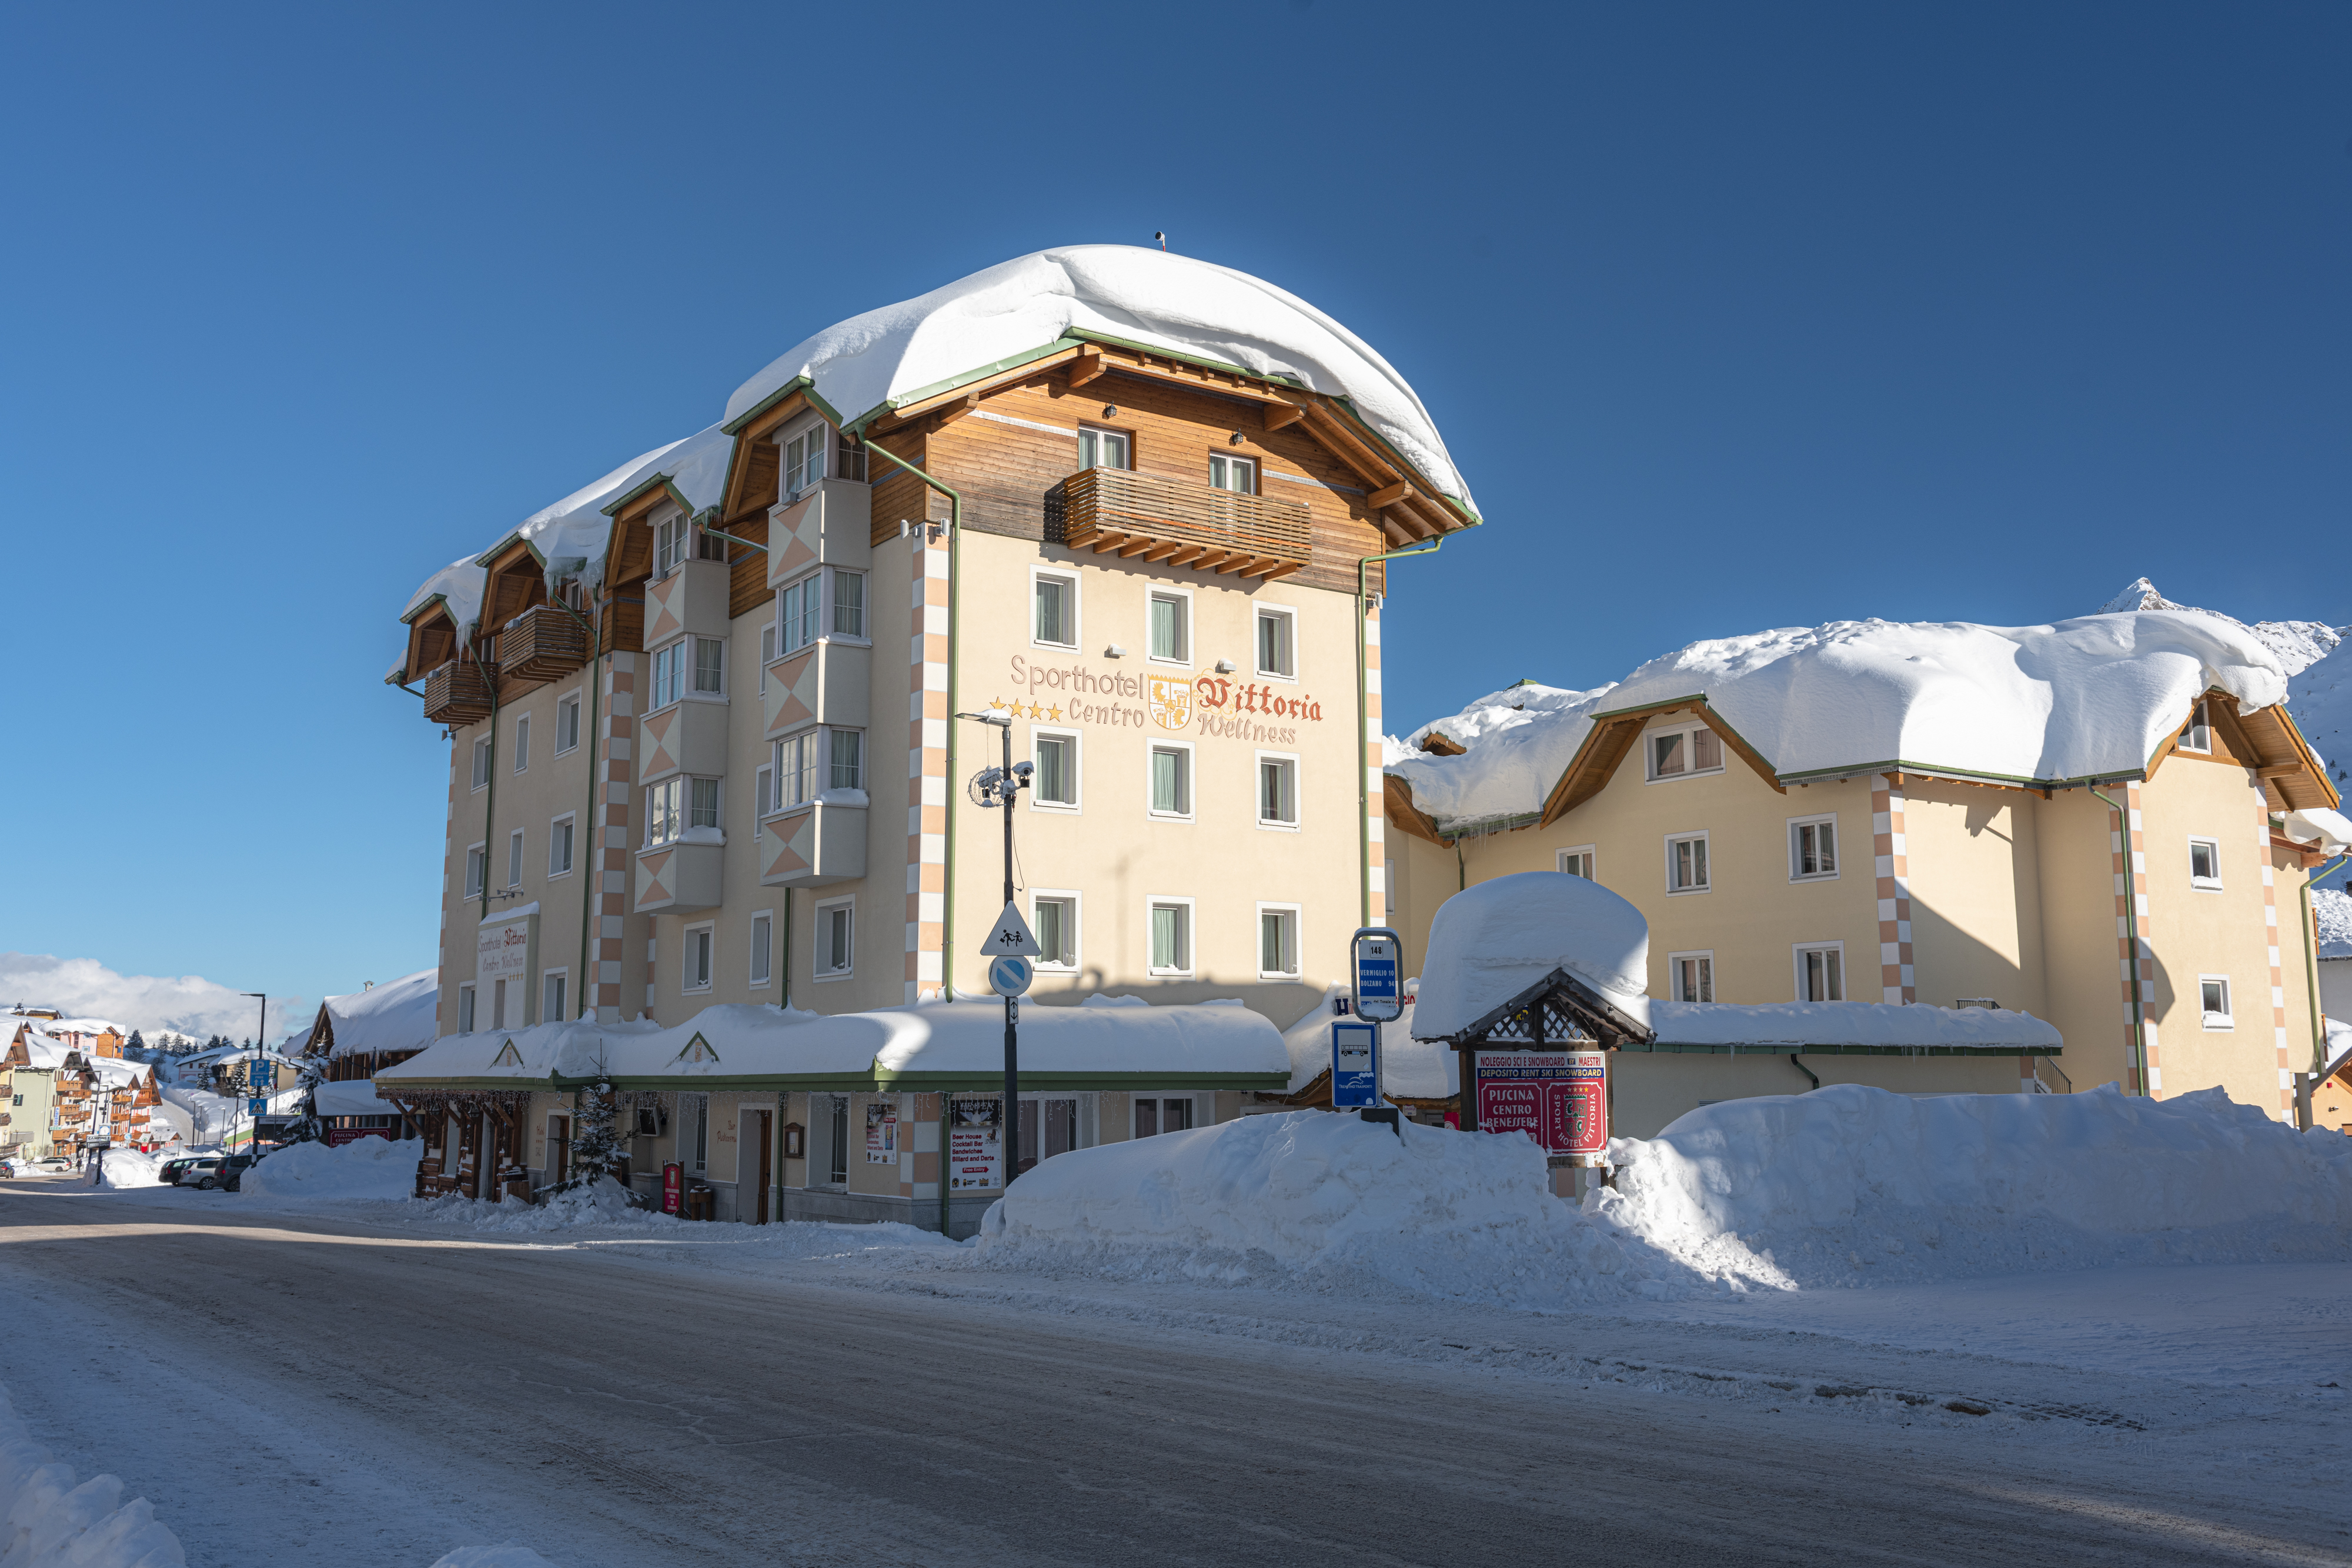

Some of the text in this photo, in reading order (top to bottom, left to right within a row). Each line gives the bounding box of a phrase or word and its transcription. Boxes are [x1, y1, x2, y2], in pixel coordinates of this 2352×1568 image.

[1011, 654, 1324, 722] Sporthotel Vittoria
[1069, 697, 1297, 745] Centro Wellness
[479, 927, 526, 957] Sporthotel Vittoria
[483, 952, 523, 972] Centro Wellness
[255, 1061, 265, 1071] P
[1480, 1057, 1512, 1067] NOLEGGIO
[1513, 1057, 1522, 1067] SCI
[1524, 1057, 1526, 1066] E
[1528, 1057, 1565, 1067] SNOWBOARD
[1578, 1057, 1601, 1066] MAESTRI
[1481, 1069, 1602, 1077] DEPOSITO RENT SKI SNOWBOARD
[1489, 1089, 1535, 1101] PISCINA
[960, 1102, 994, 1110] HEAVEN
[1492, 1105, 1532, 1115] CENTRO
[1486, 1116, 1538, 1128] BENESSERE
[1558, 1132, 1583, 1147] HOTEL
[1583, 1092, 1596, 1143] VITTORIA
